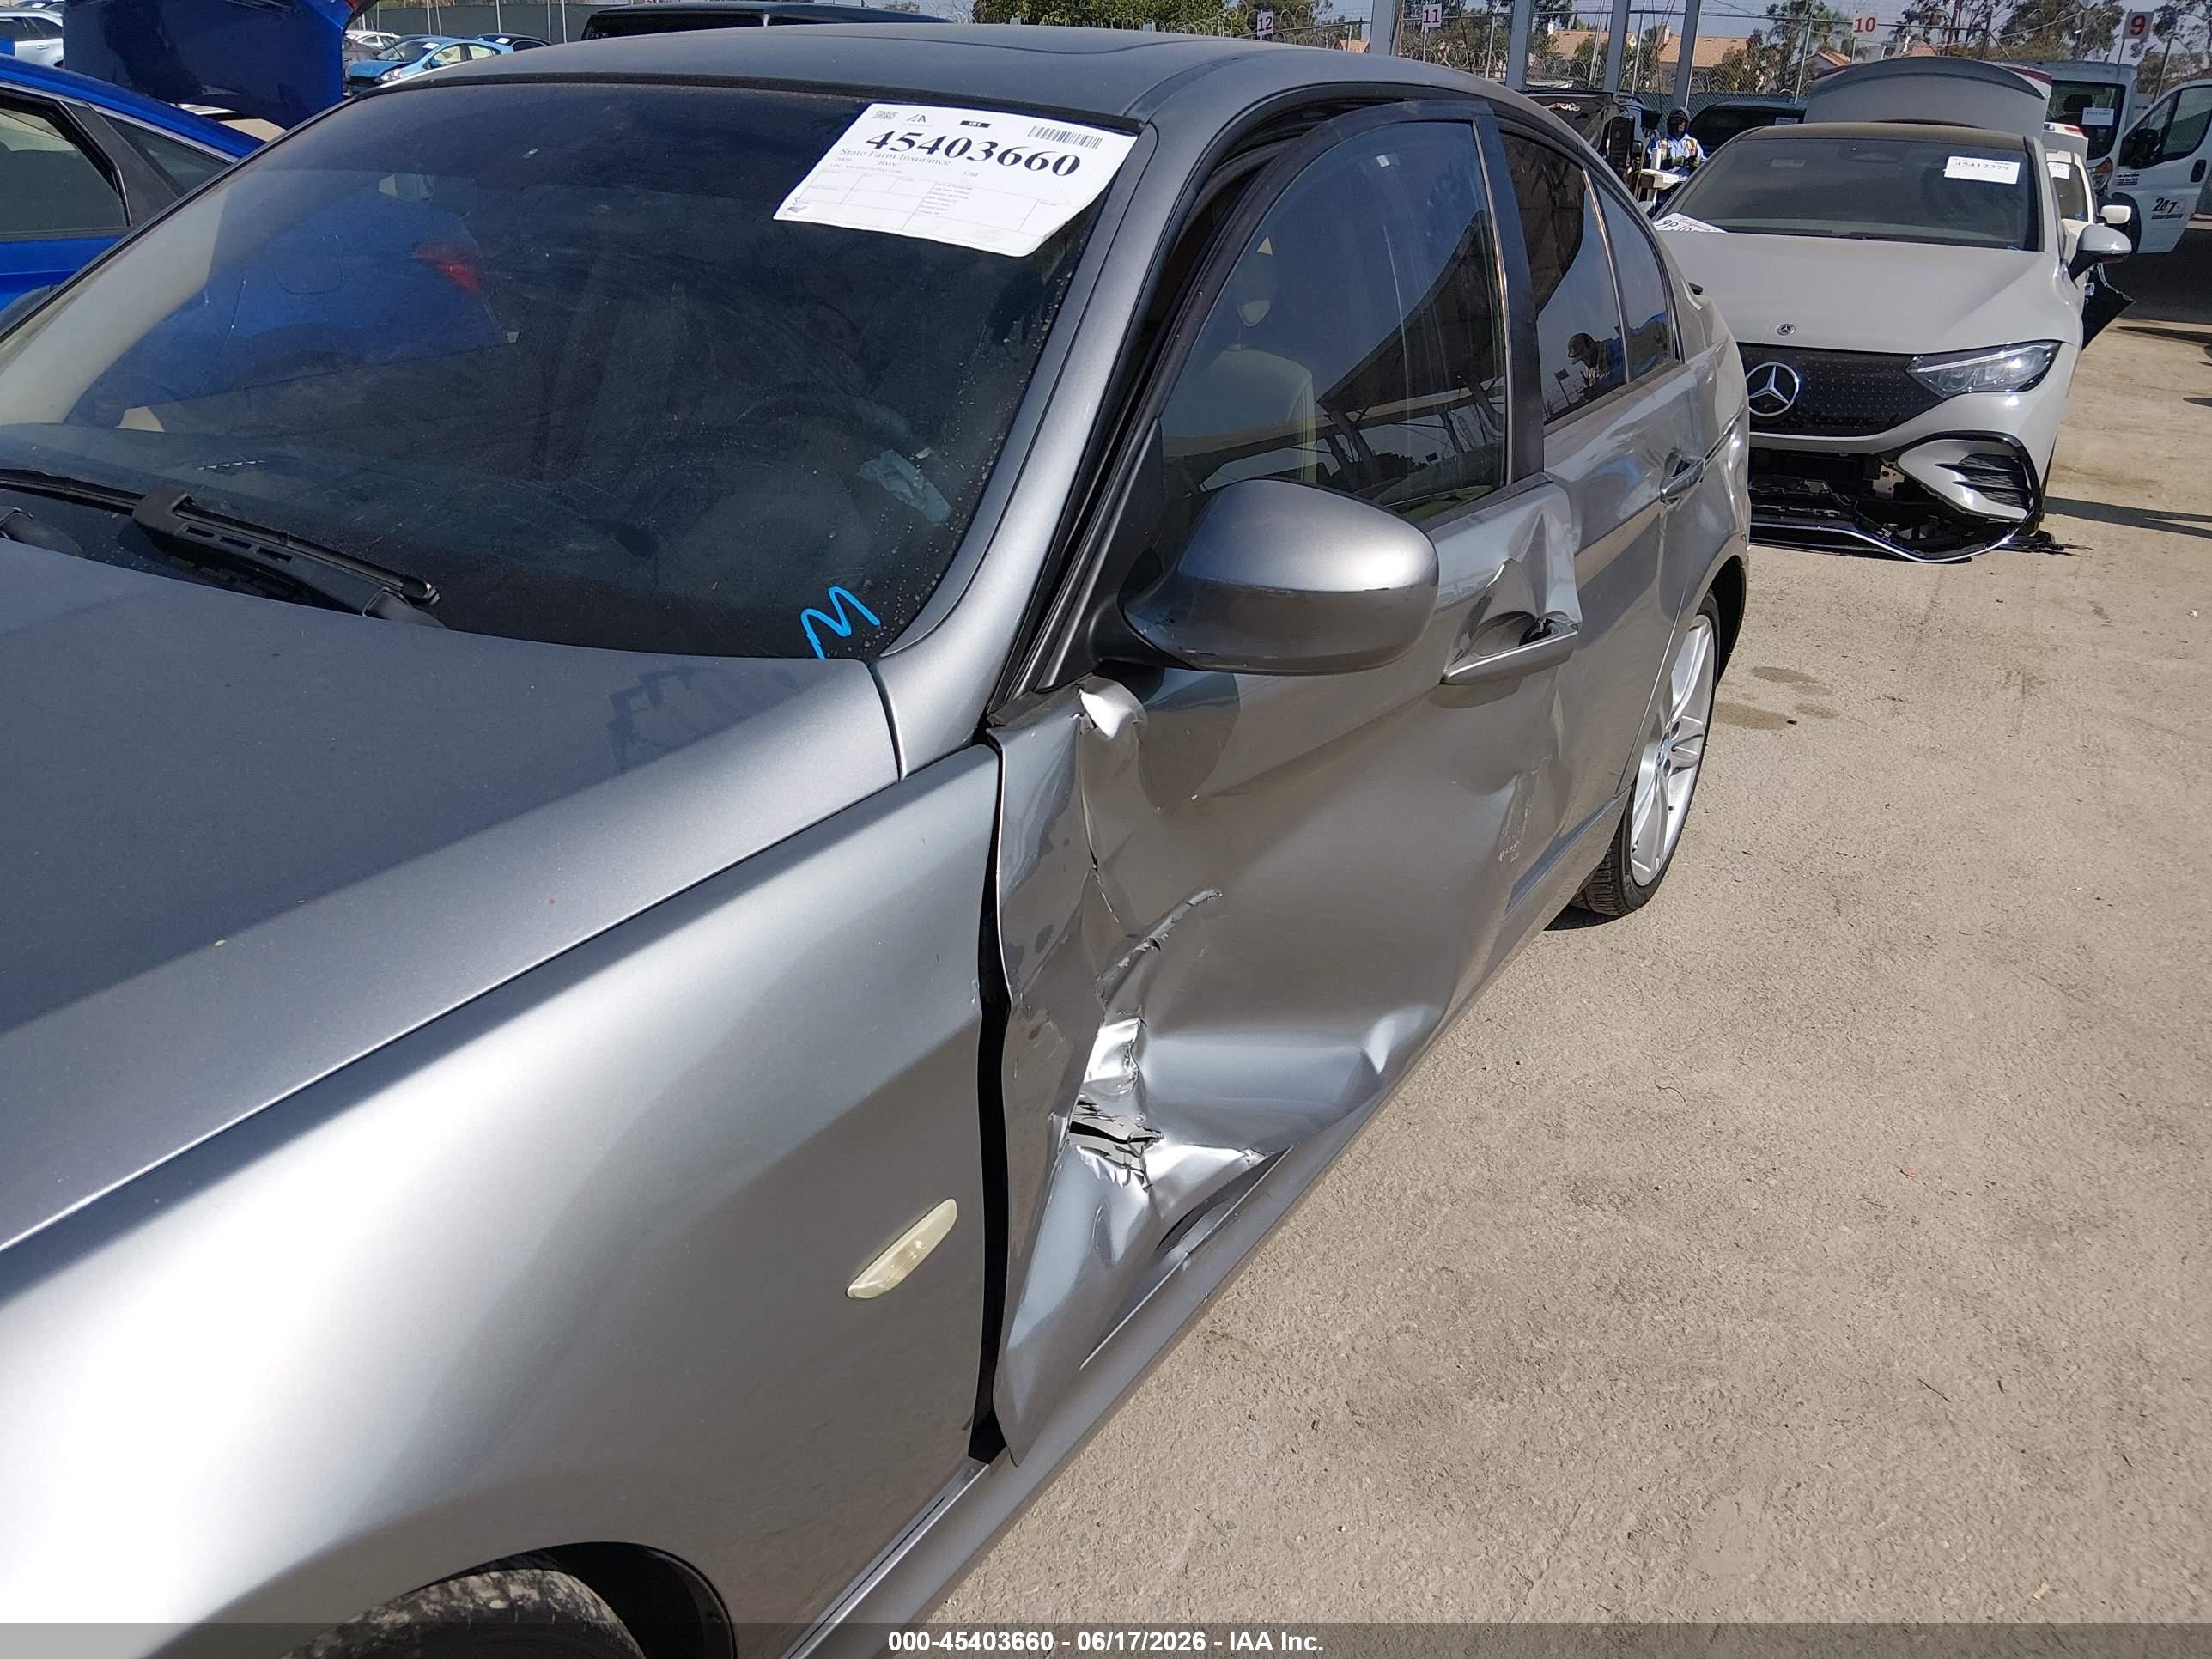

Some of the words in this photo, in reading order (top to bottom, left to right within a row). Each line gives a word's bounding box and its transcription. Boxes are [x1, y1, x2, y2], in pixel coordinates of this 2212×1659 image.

[1258, 16, 1273, 32] 12
[1423, 8, 1440, 23] 11
[1854, 17, 1876, 33] 10
[2130, 15, 2146, 35] 9
[840, 148, 866, 157] State
[868, 150, 897, 160] Farm
[899, 155, 951, 166] Insurance
[866, 131, 1080, 177] 45403660
[800, 586, 880, 659] M
